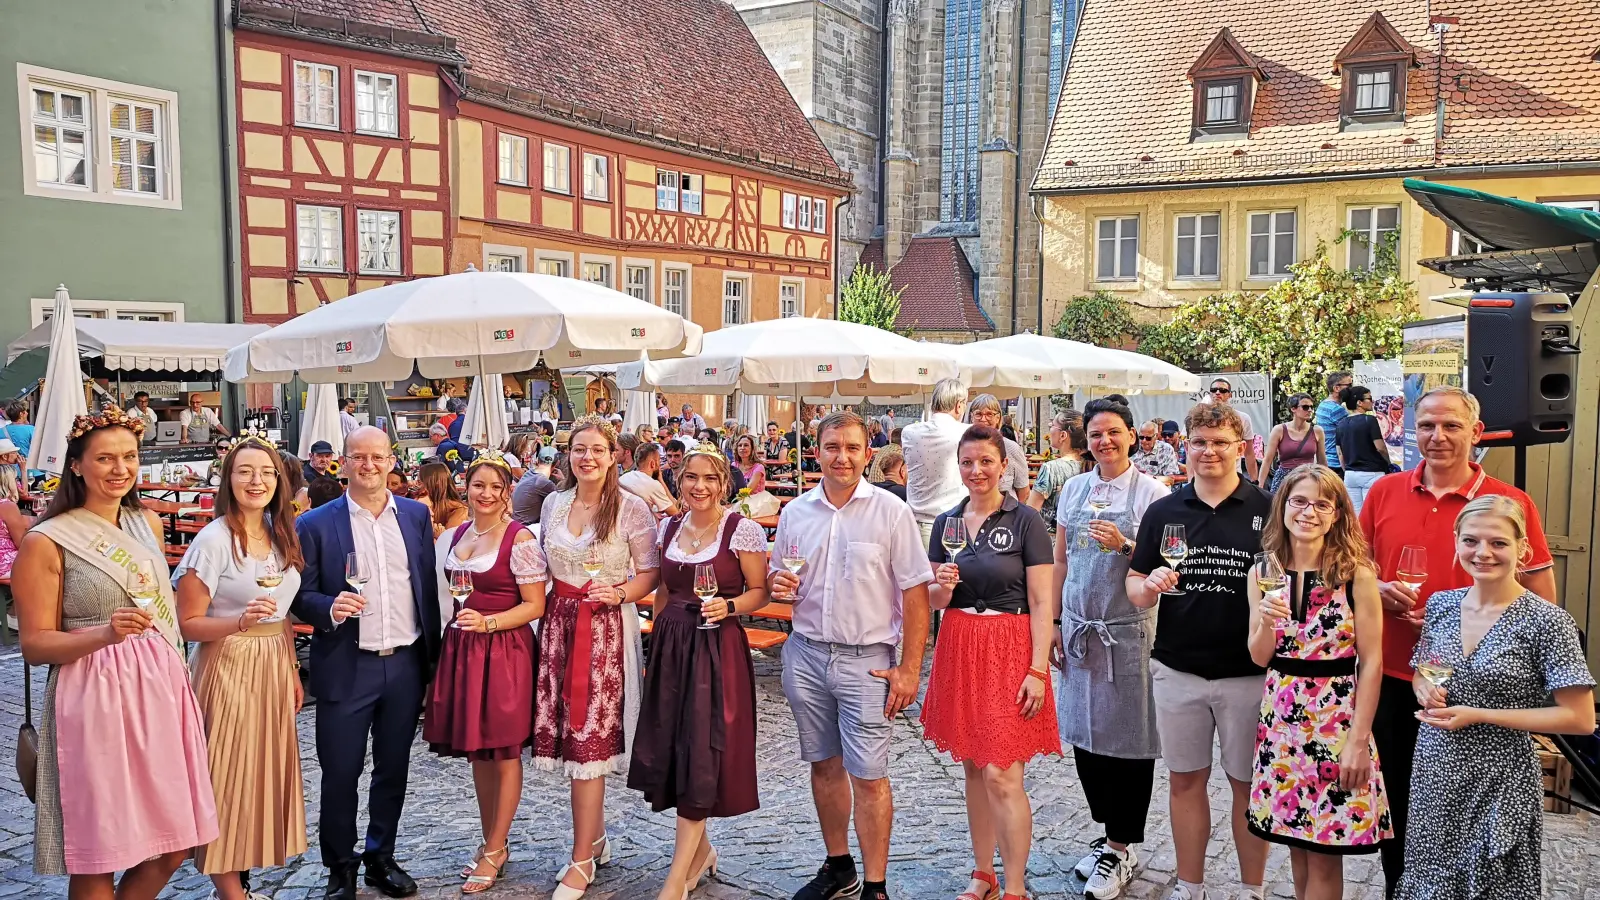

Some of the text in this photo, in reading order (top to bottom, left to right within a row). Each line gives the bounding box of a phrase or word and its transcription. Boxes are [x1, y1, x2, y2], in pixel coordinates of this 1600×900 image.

[494, 329, 514, 340] NGS
[337, 341, 352, 352] NGS
[994, 532, 1008, 546] M
[1194, 567, 1212, 575] man
[1213, 567, 1227, 576] ein
[1185, 579, 1236, 594] wein.
